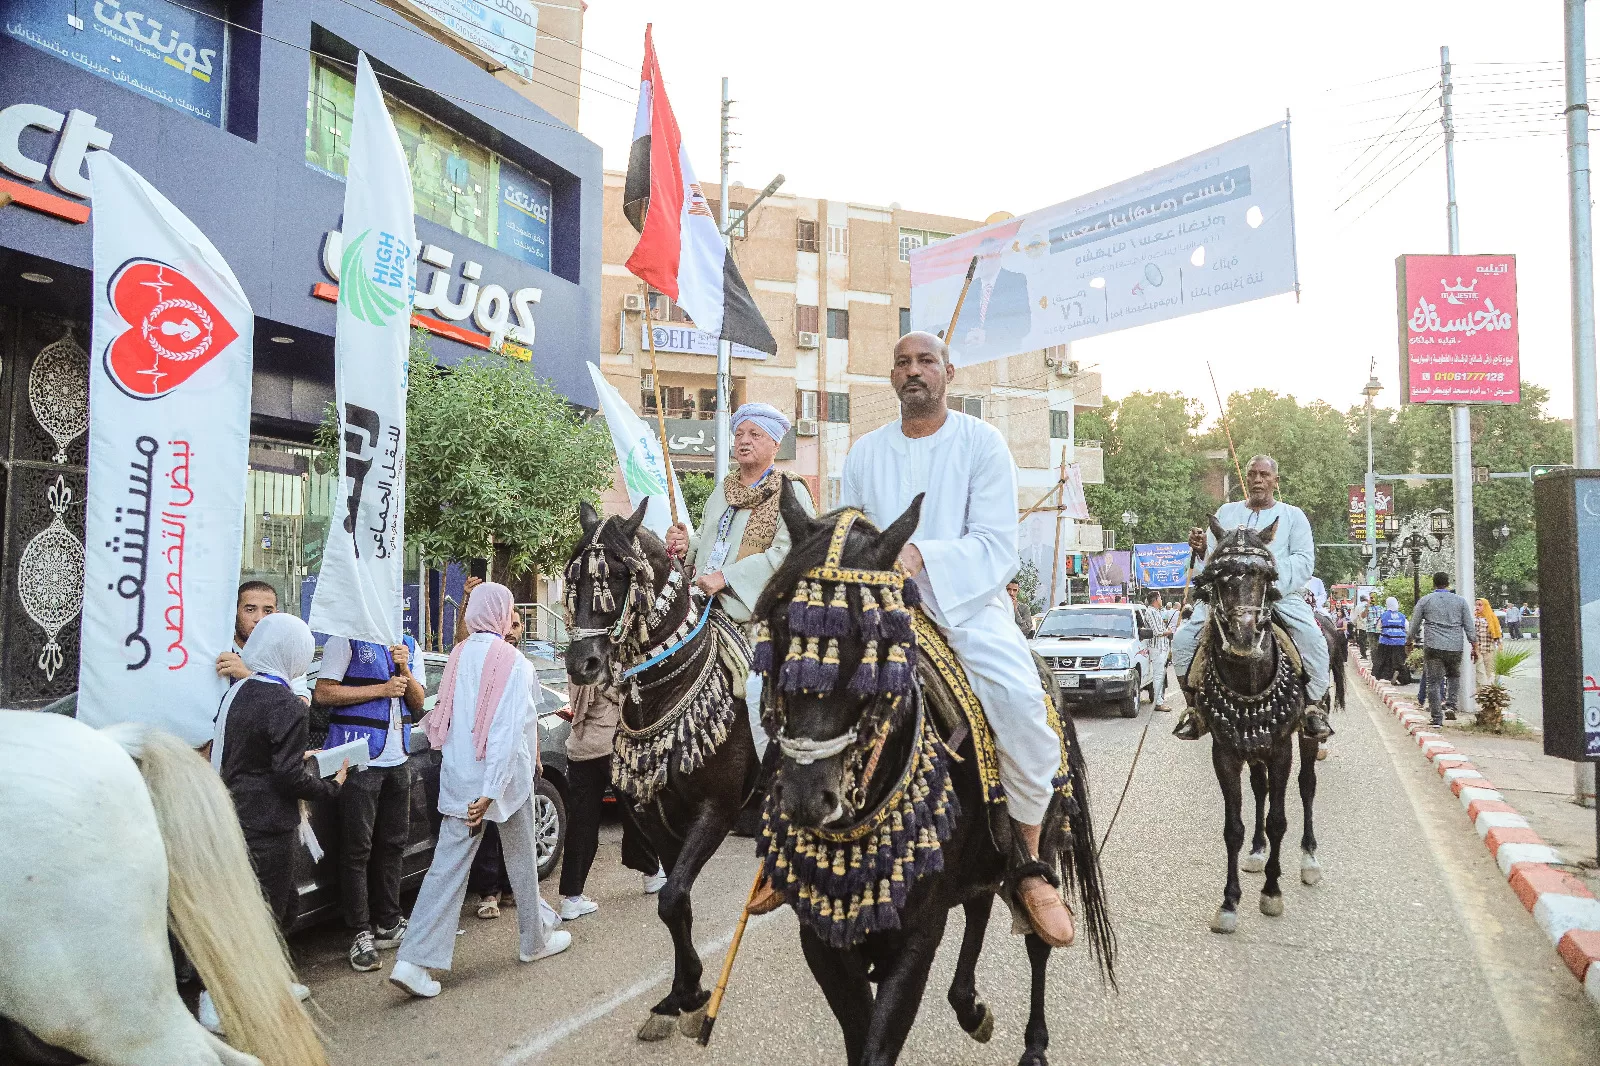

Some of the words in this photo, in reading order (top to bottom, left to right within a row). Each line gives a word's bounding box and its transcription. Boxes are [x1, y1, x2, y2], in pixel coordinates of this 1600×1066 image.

[6, 22, 69, 56] متستناش
[93, 22, 134, 47] السيارات
[94, 0, 216, 74] كونتكت
[71, 51, 110, 74] عربيتك
[135, 44, 160, 60] تمويل
[112, 69, 174, 103] متحسبهاش
[175, 97, 211, 119] فلوسك
[504, 186, 548, 220] كونتكت
[372, 231, 395, 285] HIGH
[388, 239, 411, 289] Way
[1434, 372, 1504, 381] 01061777128
[382, 425, 401, 479] للنقل
[165, 440, 195, 507] نبض
[369, 480, 393, 559] الجماعي
[105, 435, 159, 671] مستشفى
